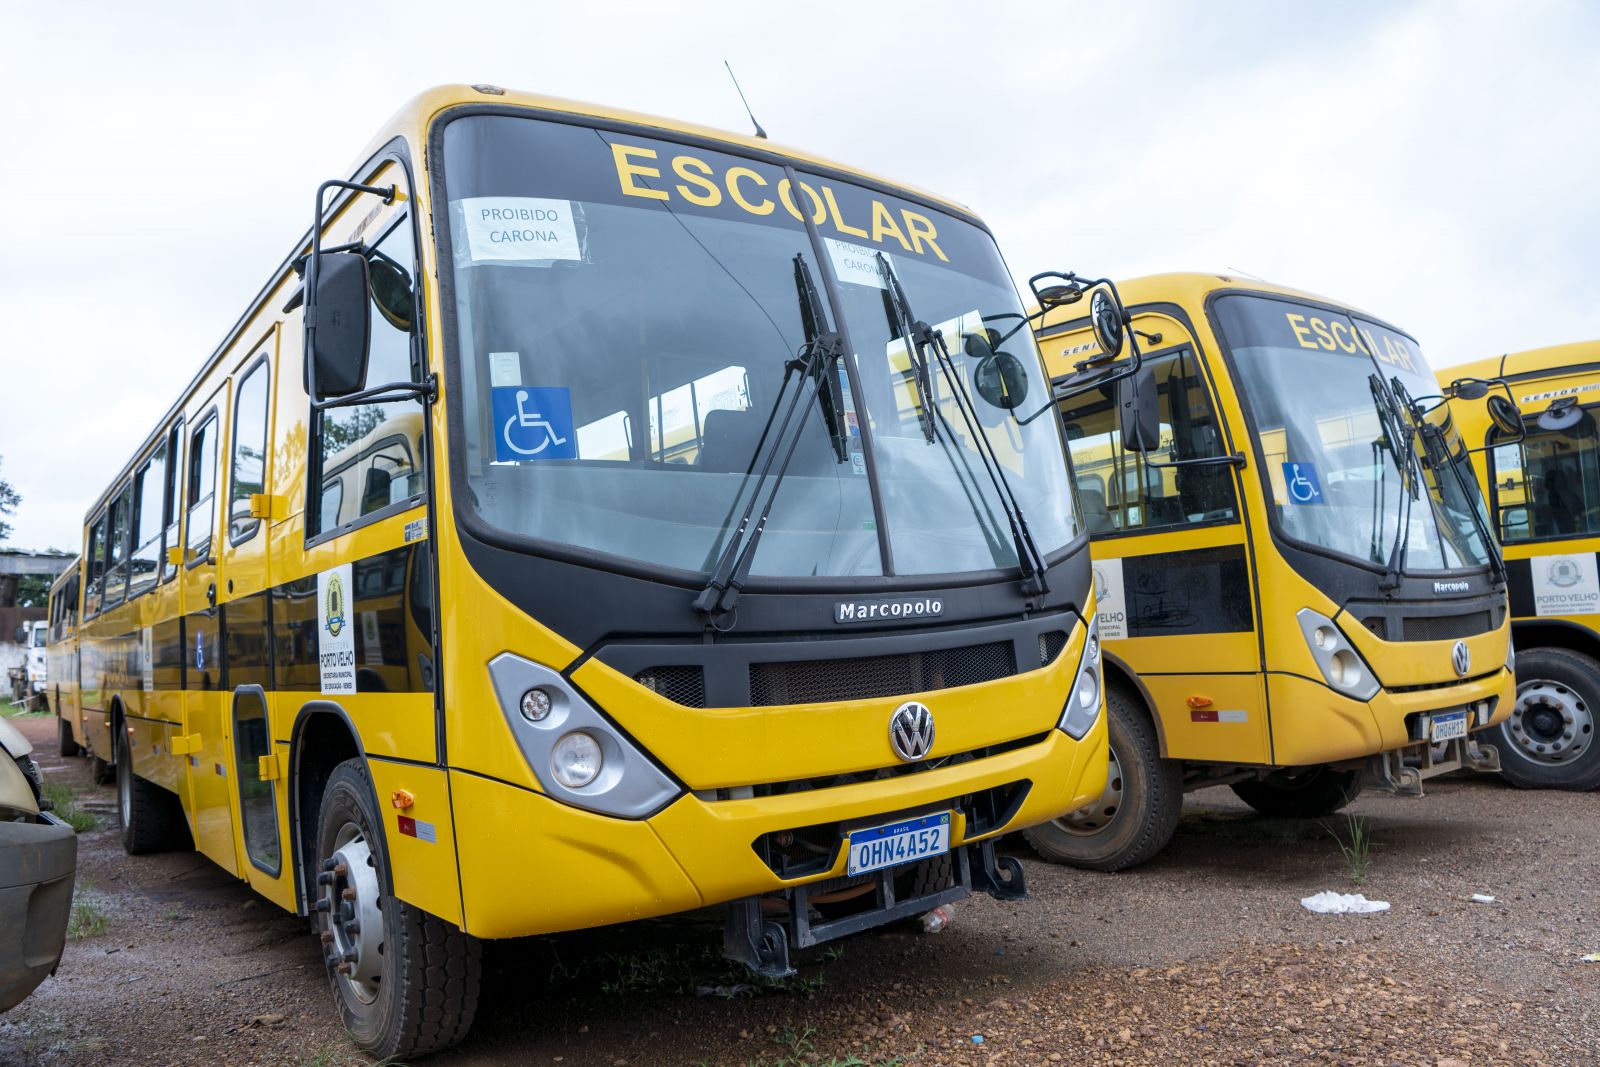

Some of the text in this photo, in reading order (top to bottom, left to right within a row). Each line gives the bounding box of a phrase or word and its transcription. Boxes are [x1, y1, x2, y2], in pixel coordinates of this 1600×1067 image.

[610, 143, 950, 262] ESCOLAR
[481, 208, 558, 222] PROIBIDO
[490, 229, 558, 243] CARONA
[835, 240, 877, 258] PROIBID
[843, 258, 879, 275] CARON
[1286, 312, 1419, 375] ESCOLAR
[1524, 388, 1578, 401] SENIOR
[1434, 581, 1469, 593] Marcopolo
[1536, 592, 1599, 604] PORTO VELHO
[840, 600, 942, 620] Marcopolo
[321, 650, 353, 668] PORTO VELHO
[893, 826, 909, 834] BRASIL
[860, 829, 940, 867] OHN4A52
